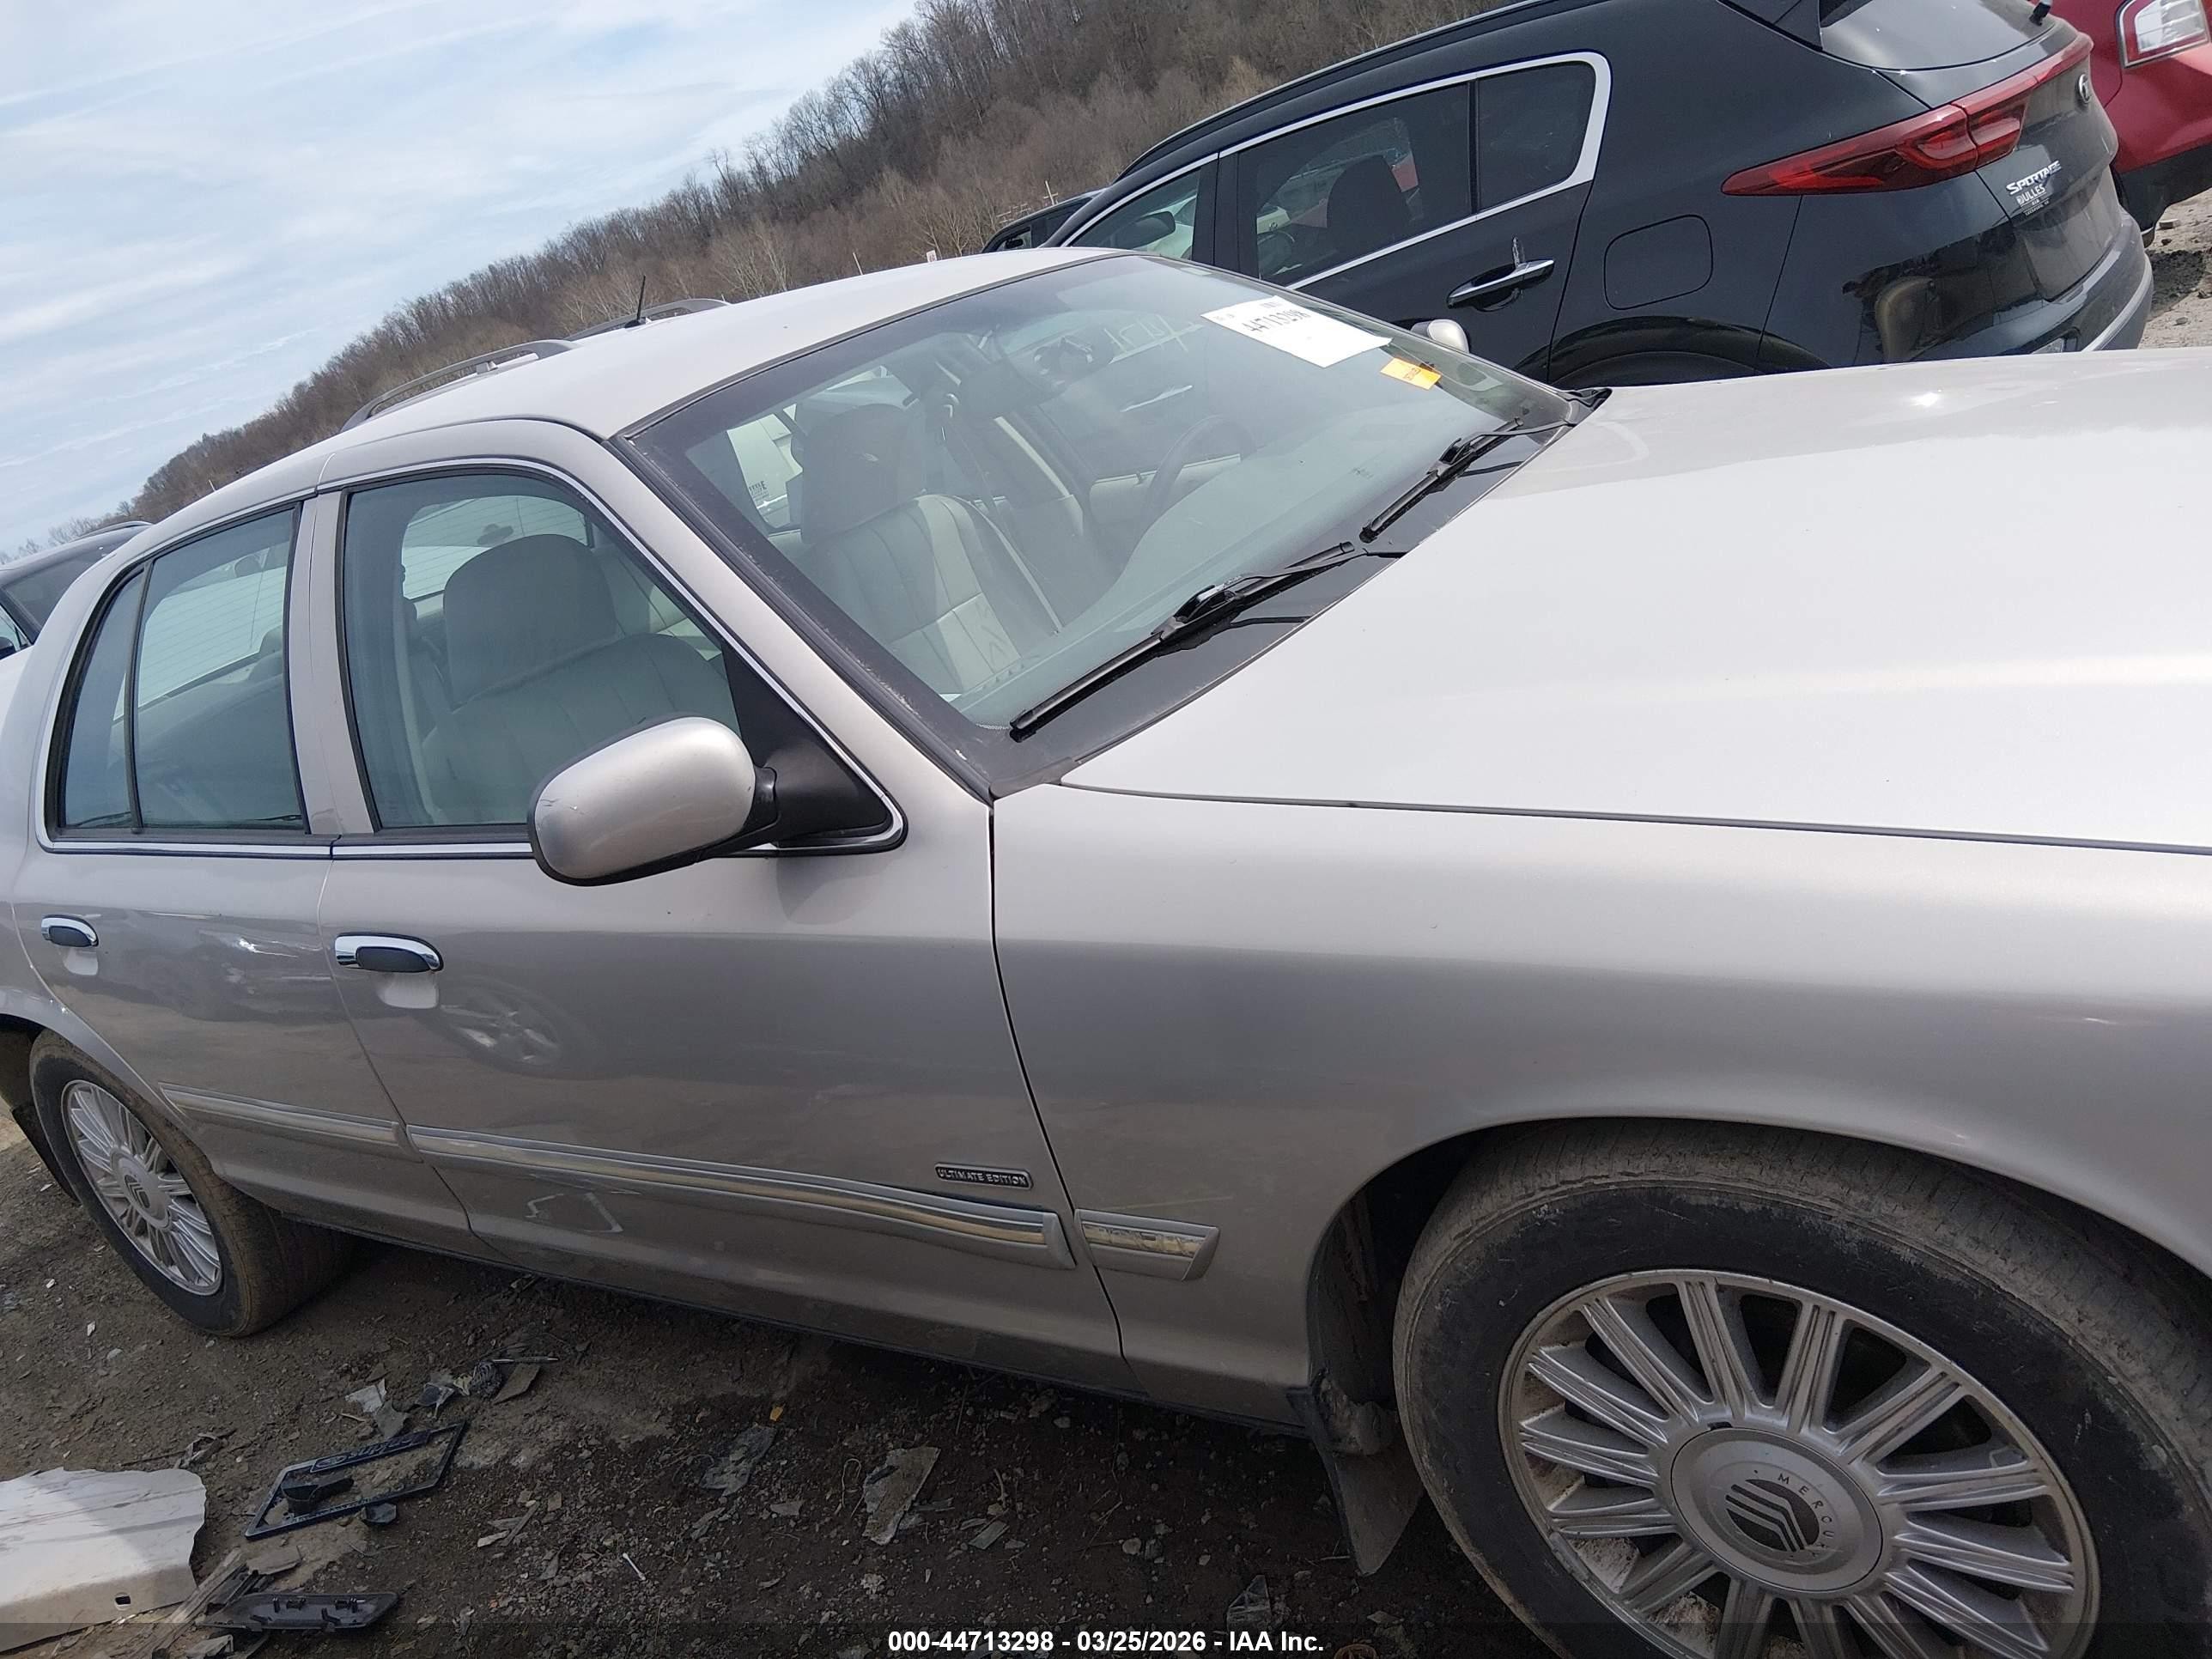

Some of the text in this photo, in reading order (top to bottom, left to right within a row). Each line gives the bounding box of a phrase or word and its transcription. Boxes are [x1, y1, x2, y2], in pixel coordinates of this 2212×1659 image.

[2006, 160, 2062, 195] SPORTAGE
[2015, 184, 2046, 204] DULLES
[938, 1169, 1026, 1185] ULTIMATE EDITION
